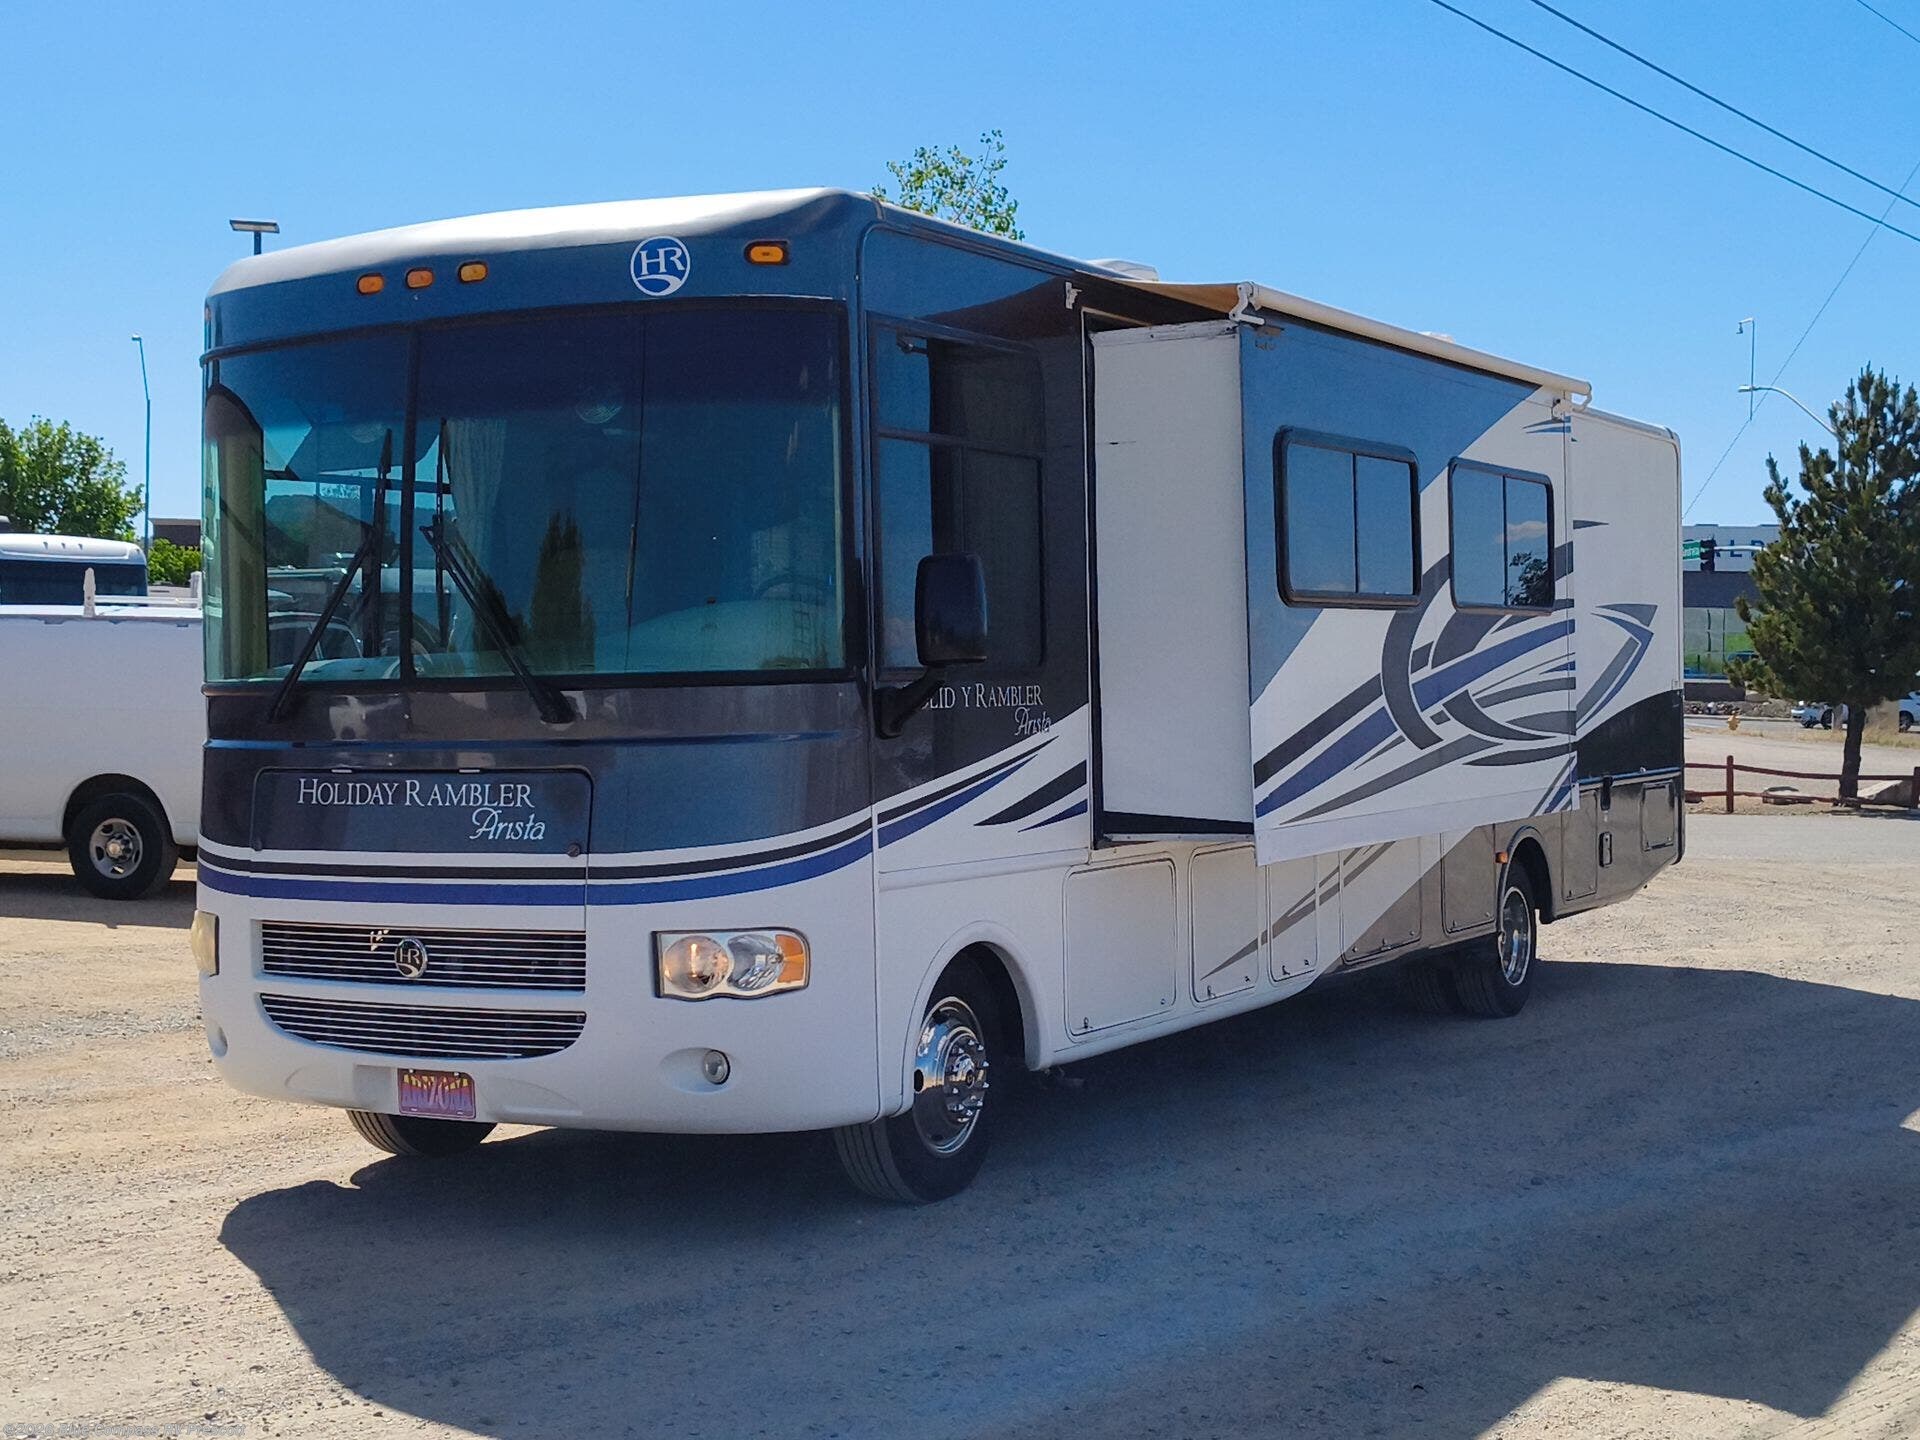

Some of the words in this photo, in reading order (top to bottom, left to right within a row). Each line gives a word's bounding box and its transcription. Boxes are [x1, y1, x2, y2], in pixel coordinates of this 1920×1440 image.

[639, 246, 686, 275] HR
[974, 682, 1044, 709] RAMBLER
[297, 777, 400, 805] HOLIDAY
[404, 778, 535, 808] RAMBLER
[469, 806, 546, 841] Arista
[397, 947, 421, 965] HR
